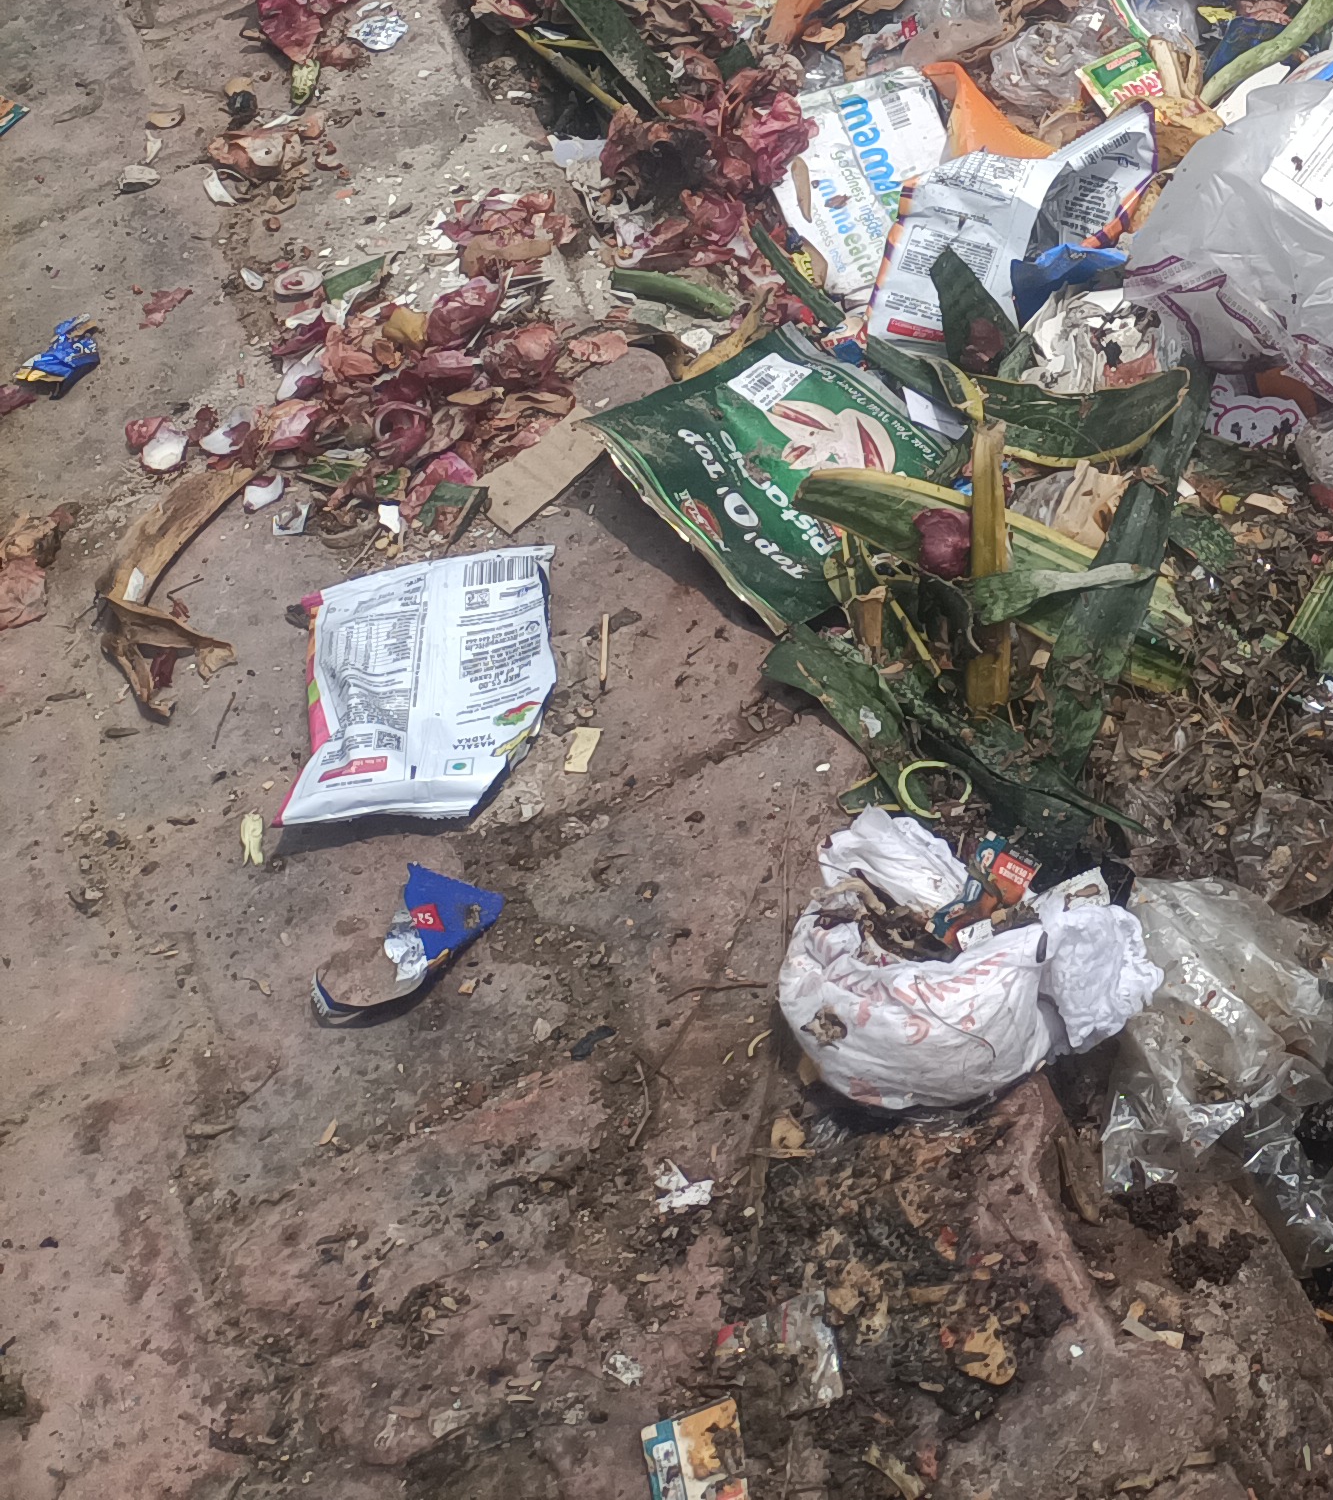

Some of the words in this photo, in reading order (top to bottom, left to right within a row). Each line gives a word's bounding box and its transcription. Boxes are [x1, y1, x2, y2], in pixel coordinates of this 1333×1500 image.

[812, 203, 834, 249] oodness
[719, 429, 834, 557] Pistacio
[452, 738, 496, 751] MASALA
[456, 731, 493, 745] TADKA
